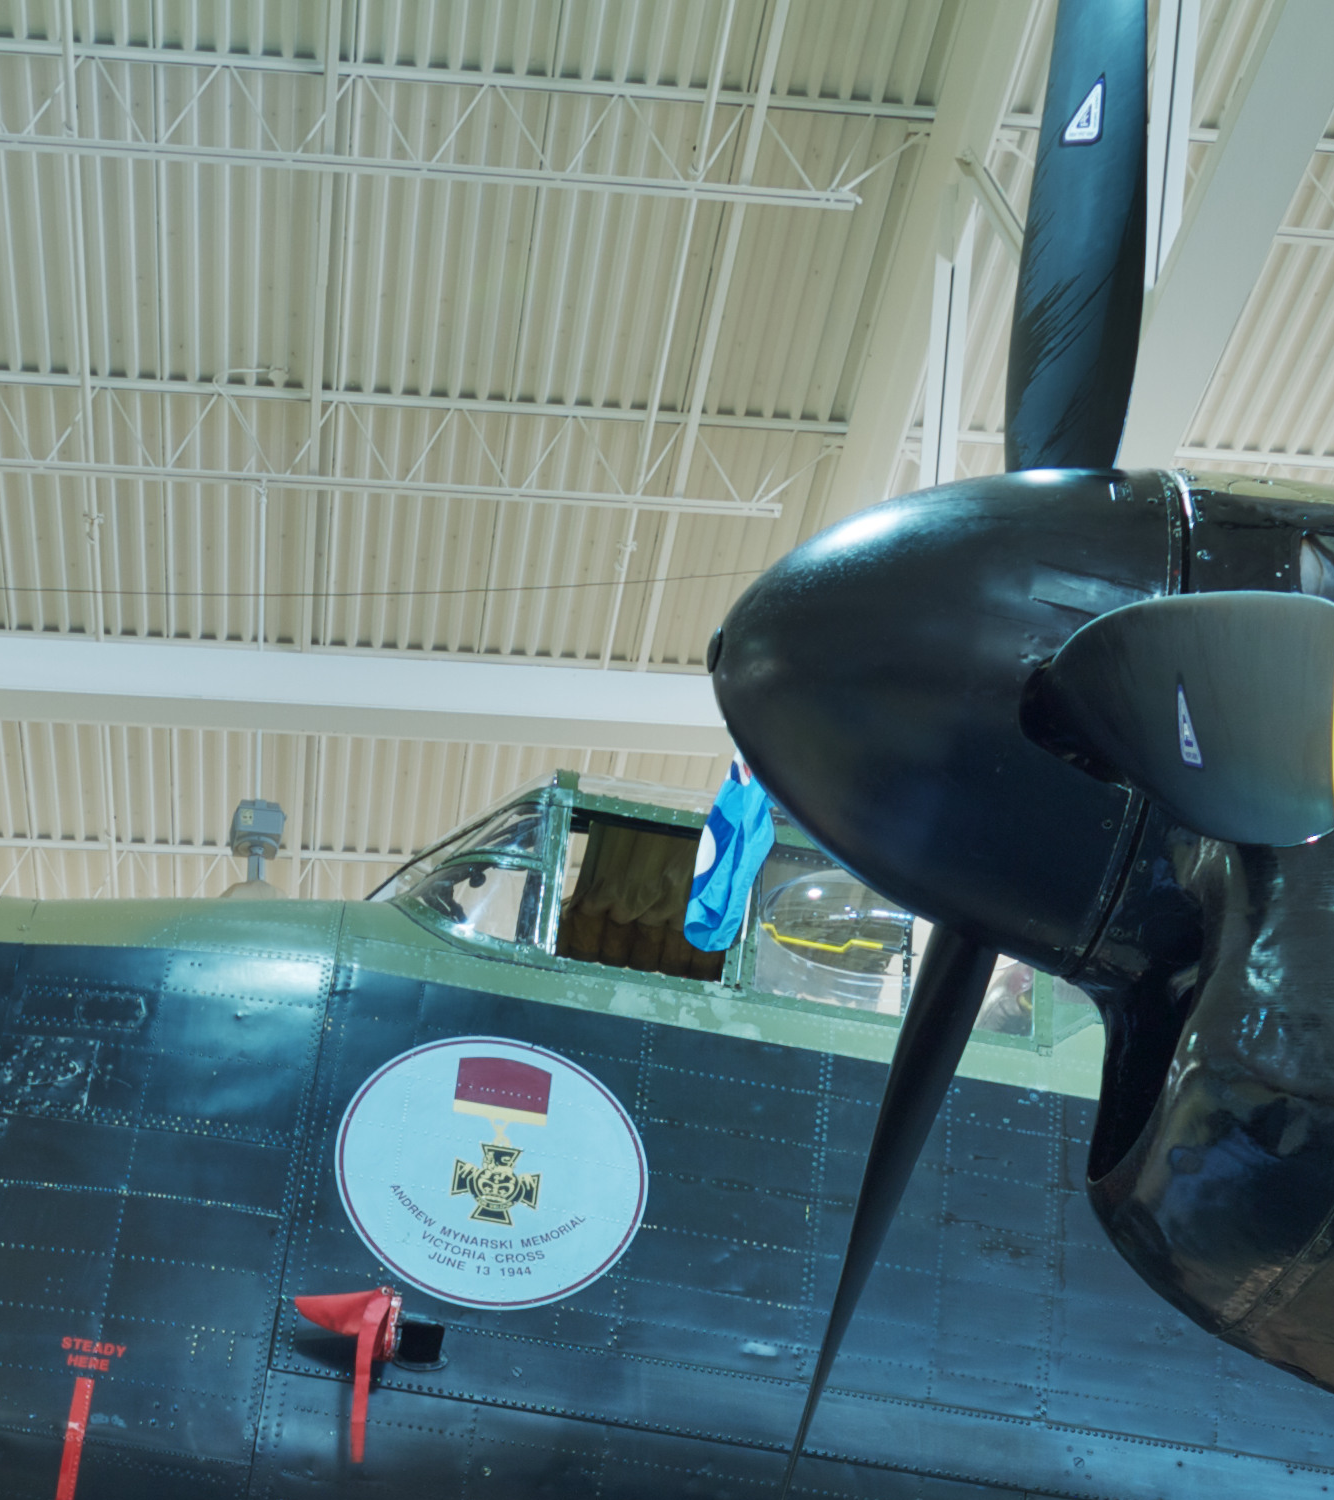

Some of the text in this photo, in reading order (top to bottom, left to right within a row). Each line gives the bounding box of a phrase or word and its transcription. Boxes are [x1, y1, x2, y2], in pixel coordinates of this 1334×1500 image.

[390, 1184, 586, 1250] ANDREW MYNARSKI MEMORIAL
[422, 1230, 545, 1264] VICTORIA CROSS
[428, 1251, 532, 1277] JUNE 13 1944
[61, 1336, 126, 1358] STEADY
[67, 1354, 109, 1372] HERE
